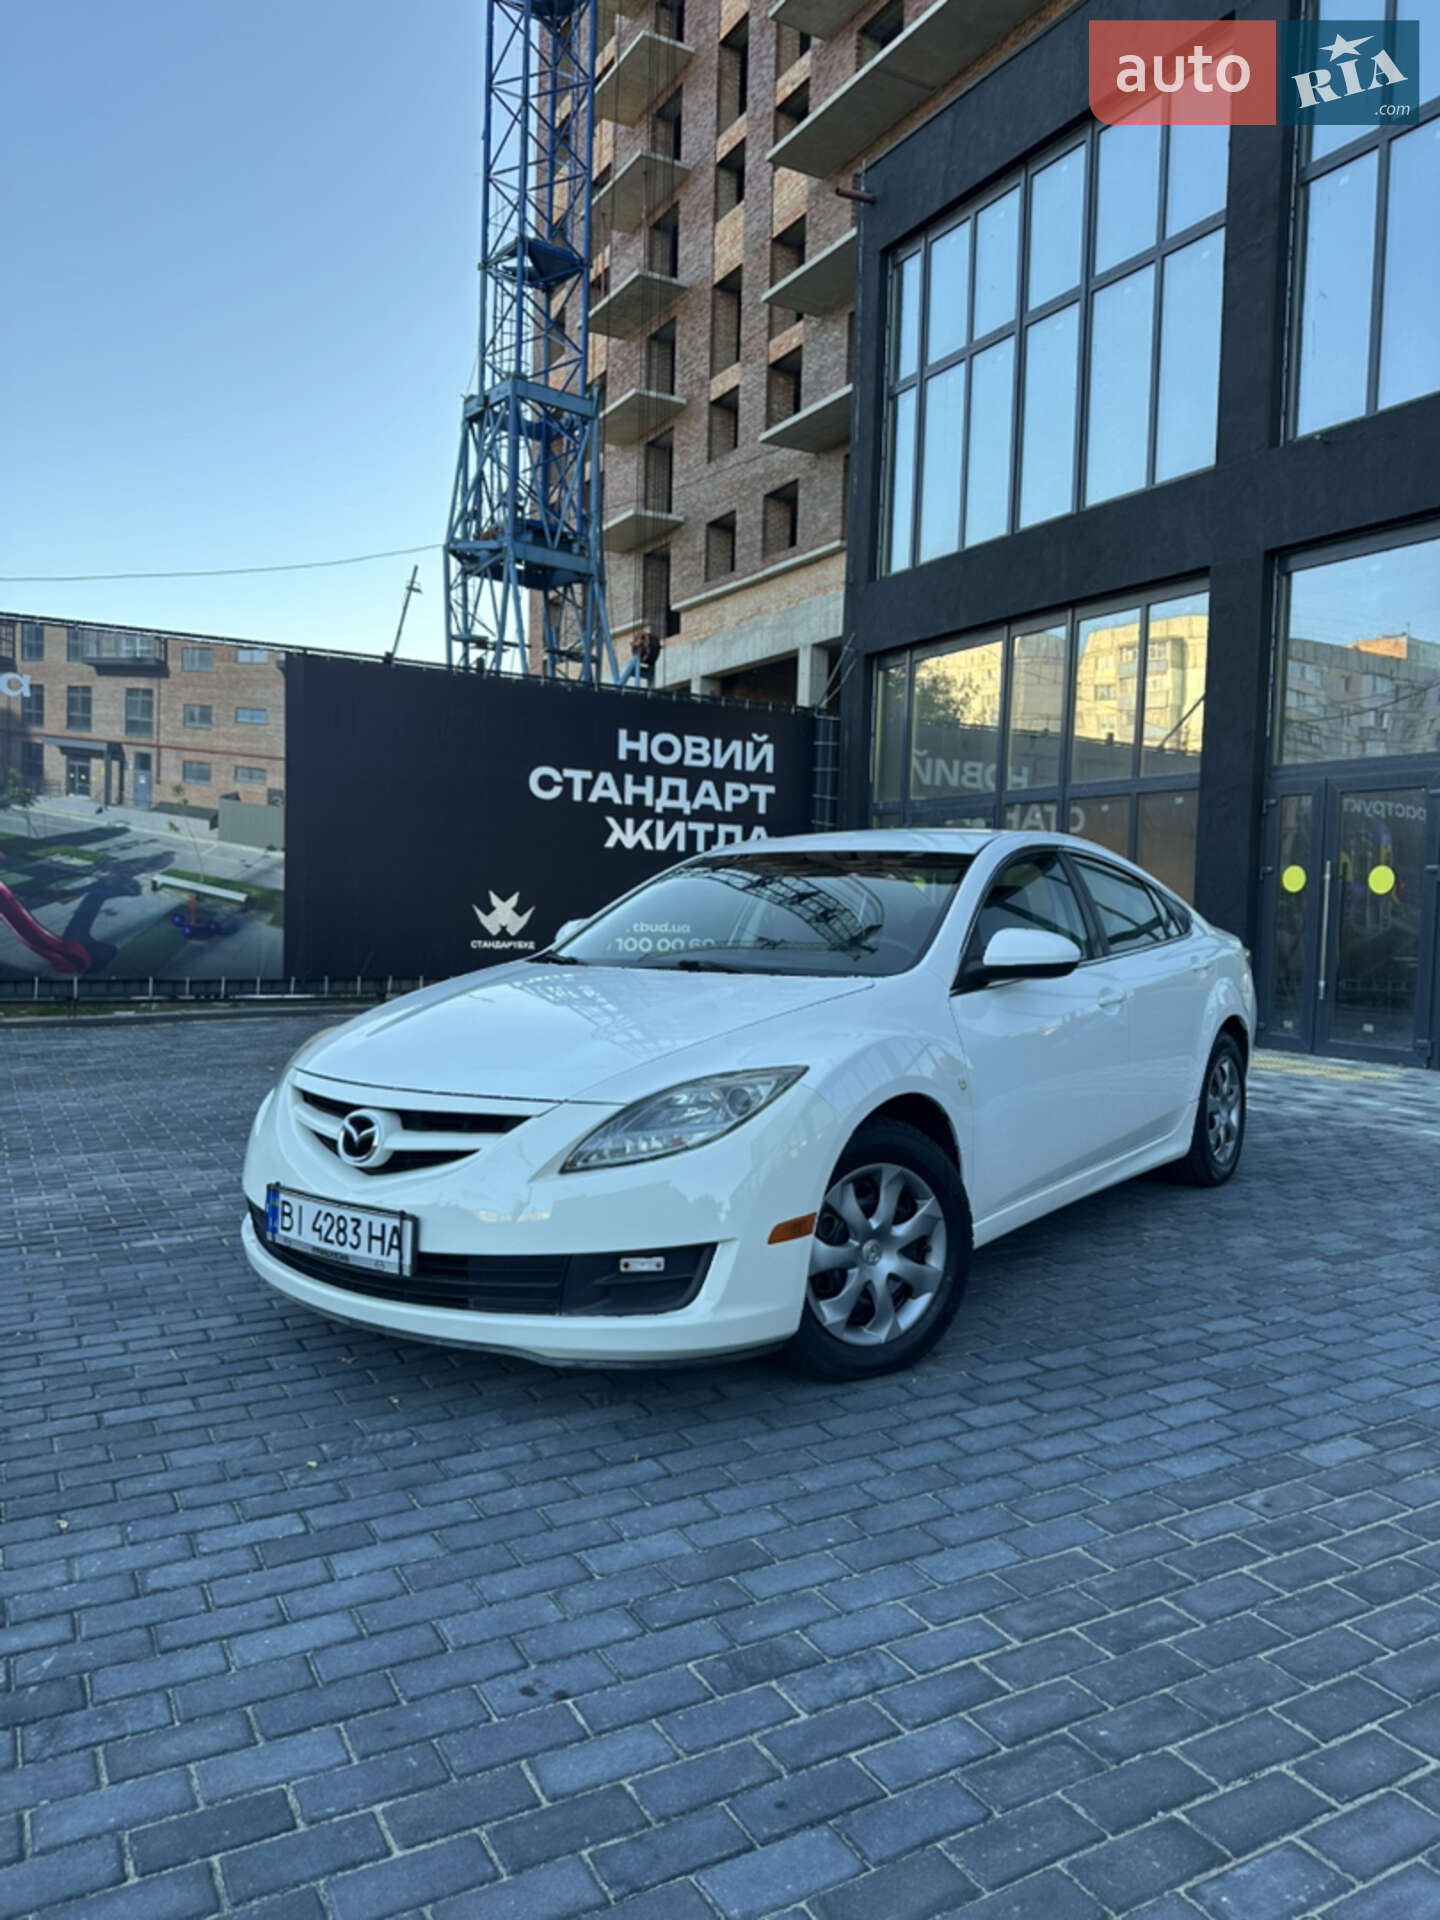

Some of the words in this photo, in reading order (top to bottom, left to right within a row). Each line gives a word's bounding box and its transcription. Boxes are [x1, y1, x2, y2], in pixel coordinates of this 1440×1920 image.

[617, 728, 775, 774] НОВИЙ
[528, 765, 776, 815] СТАНДАРТ
[311, 1209, 362, 1250] 4283
